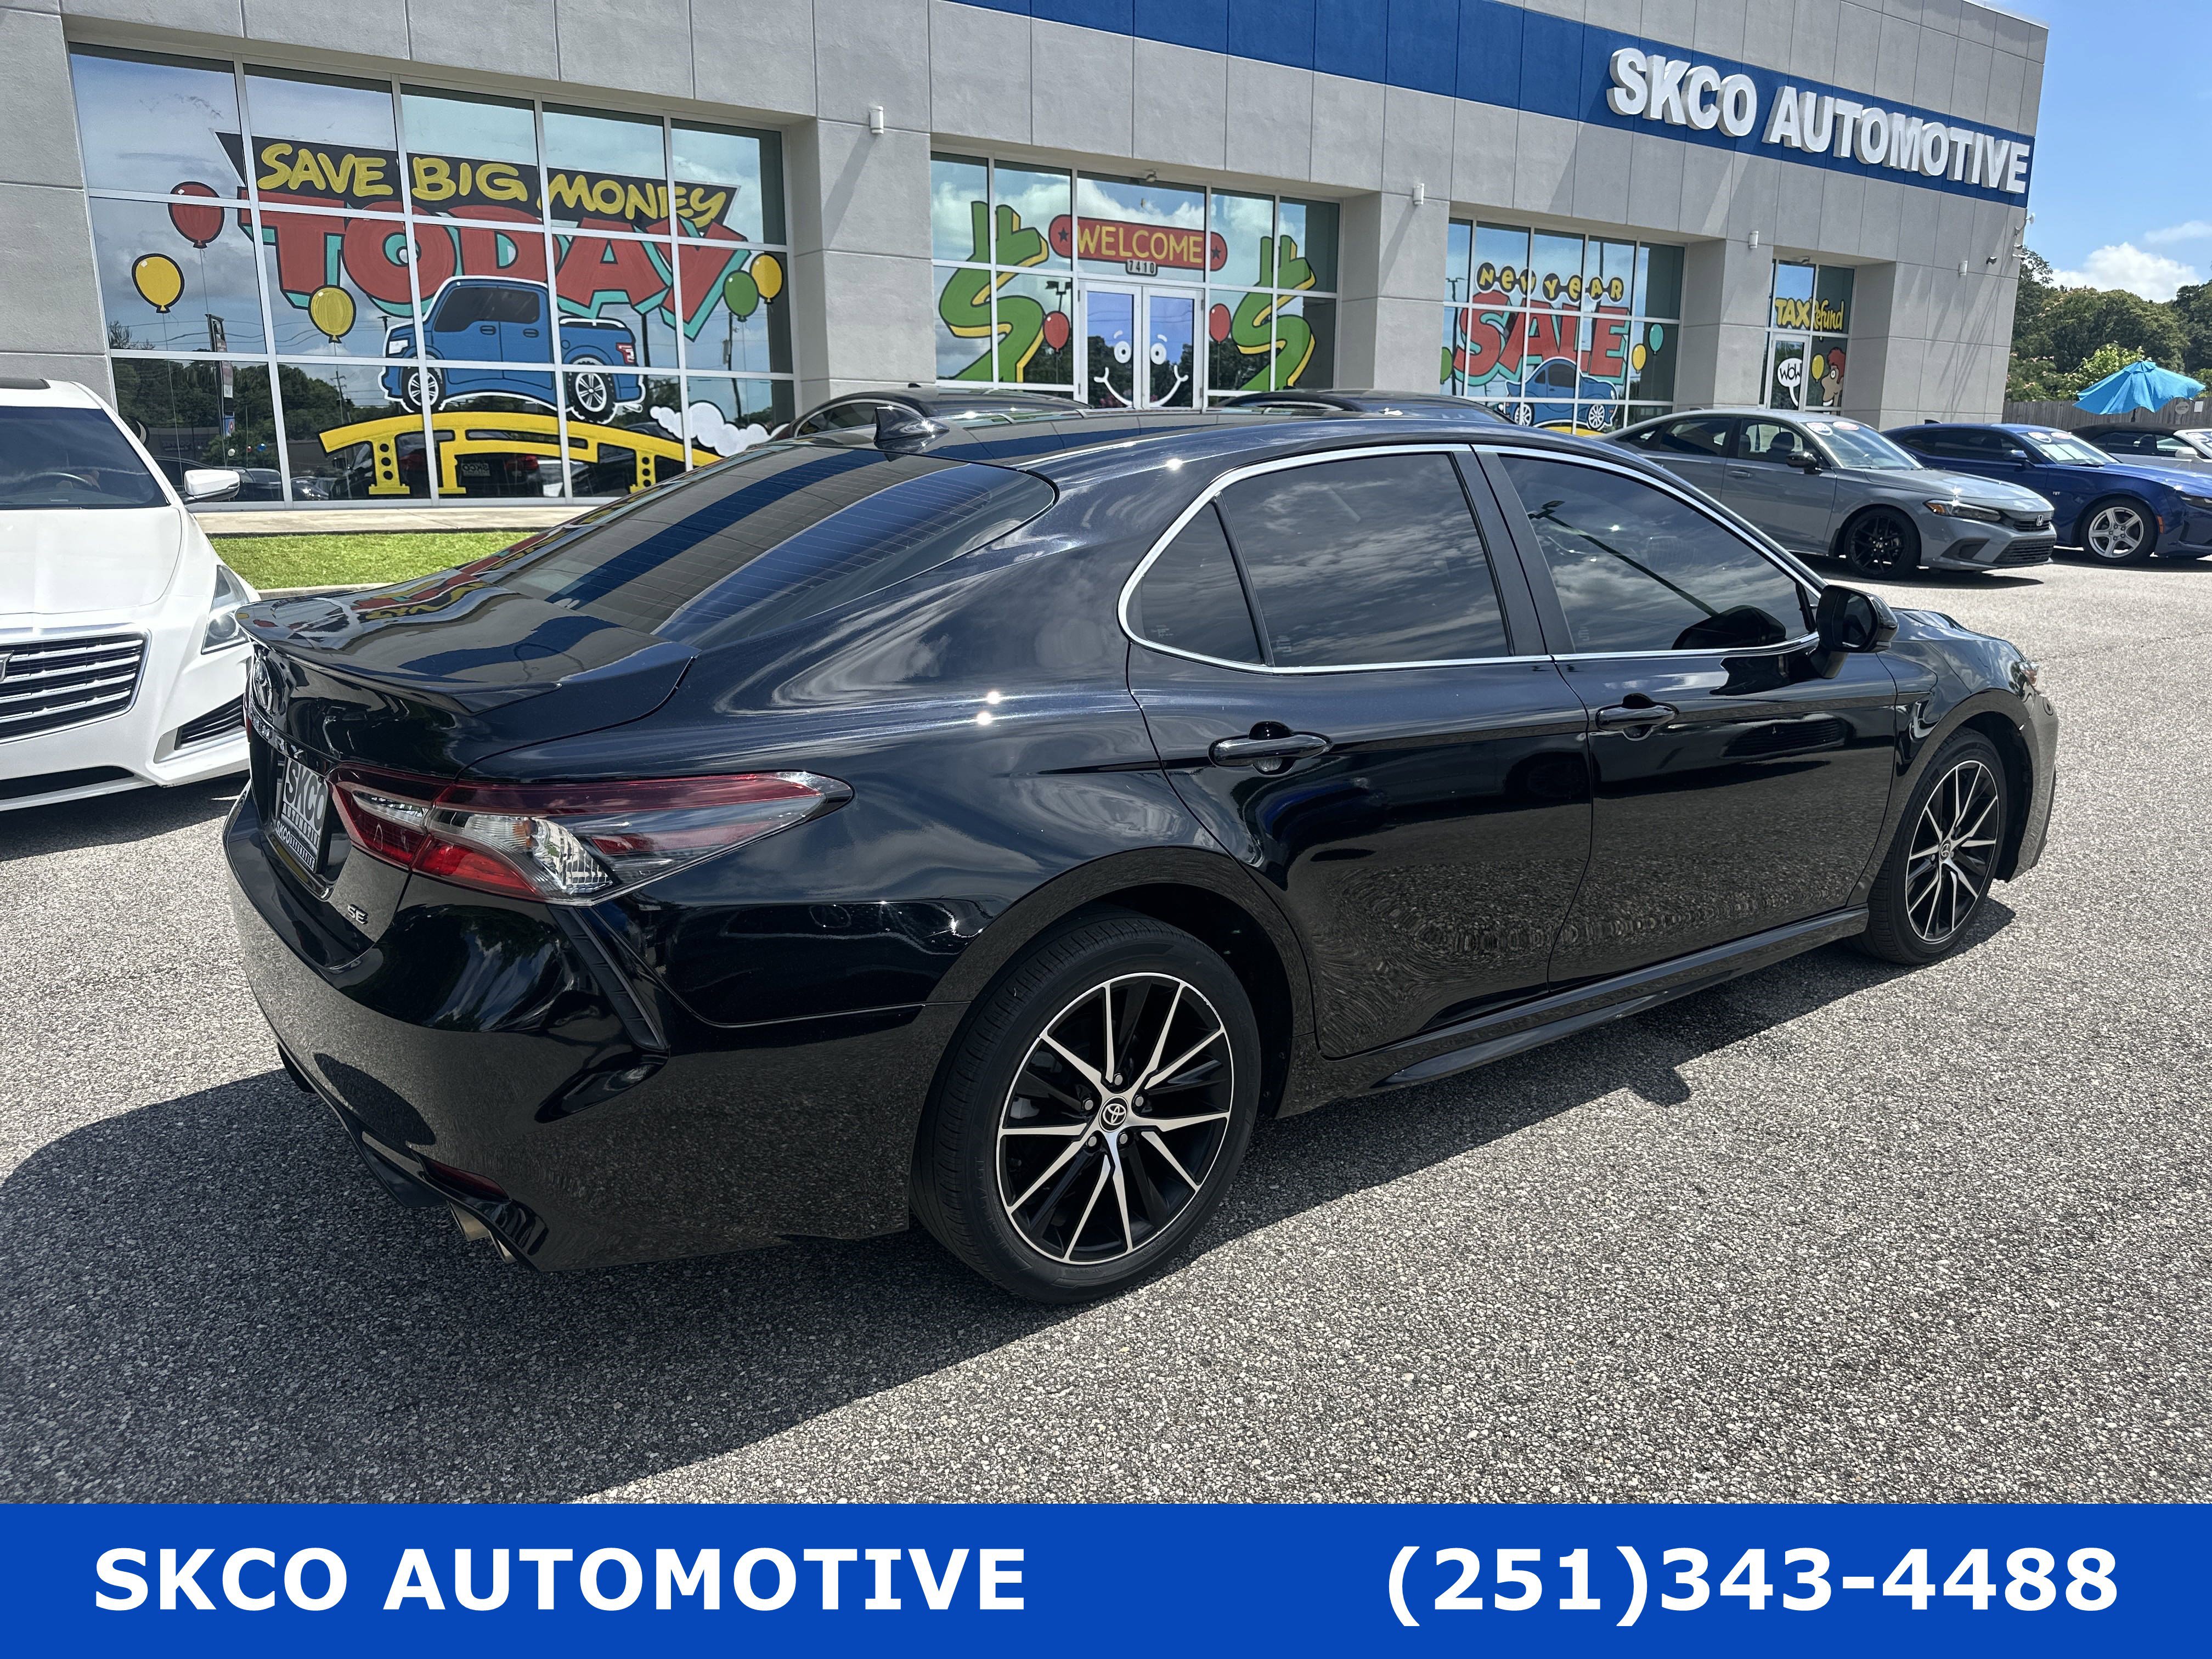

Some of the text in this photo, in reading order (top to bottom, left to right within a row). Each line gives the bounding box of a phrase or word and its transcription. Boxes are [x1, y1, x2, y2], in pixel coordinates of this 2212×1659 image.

[1606, 48, 2030, 194] SKCO AUTOMOTIVE
[257, 143, 726, 228] SAVE BIG MONEY
[238, 187, 751, 341] TODAY
[1077, 225, 1203, 263] WELCOME
[1129, 260, 1155, 274] 7410
[1453, 289, 1630, 387] SALE
[1775, 298, 1810, 328] TAX
[285, 760, 329, 831] SKCO
[275, 820, 291, 844] SKCO
[347, 904, 369, 925] SE
